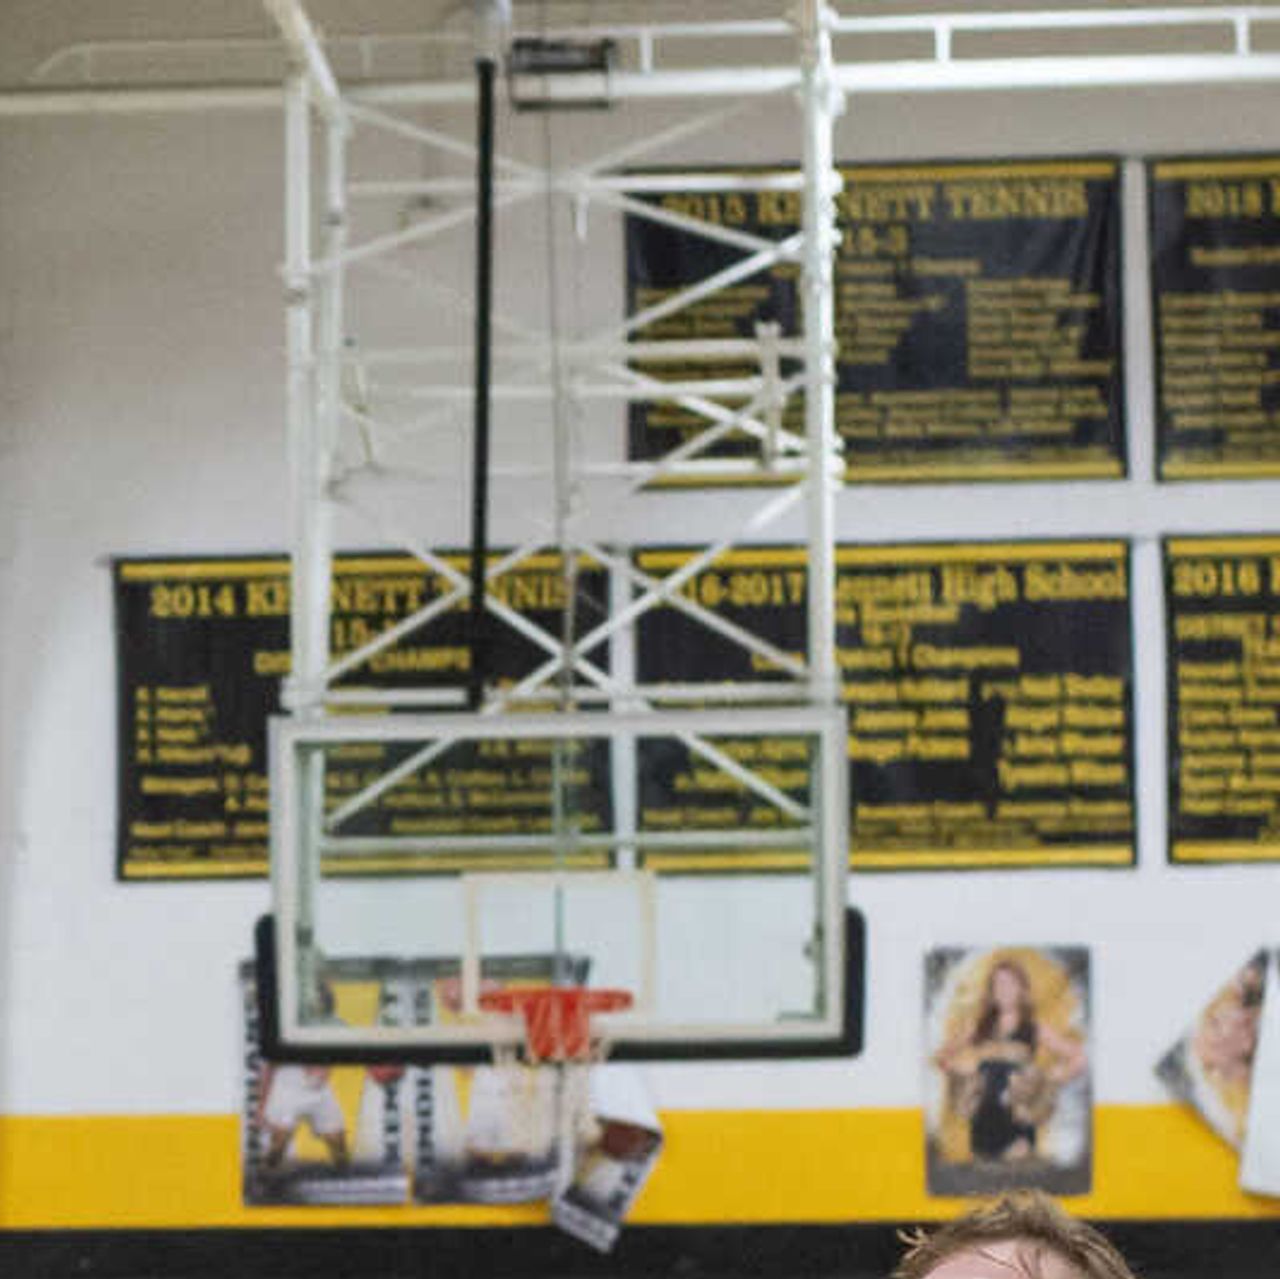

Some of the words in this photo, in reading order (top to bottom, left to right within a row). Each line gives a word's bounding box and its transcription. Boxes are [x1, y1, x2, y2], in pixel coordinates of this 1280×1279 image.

[758, 182, 934, 223] KENETT
[149, 582, 237, 617] 2014
[247, 575, 425, 615] KENETT
